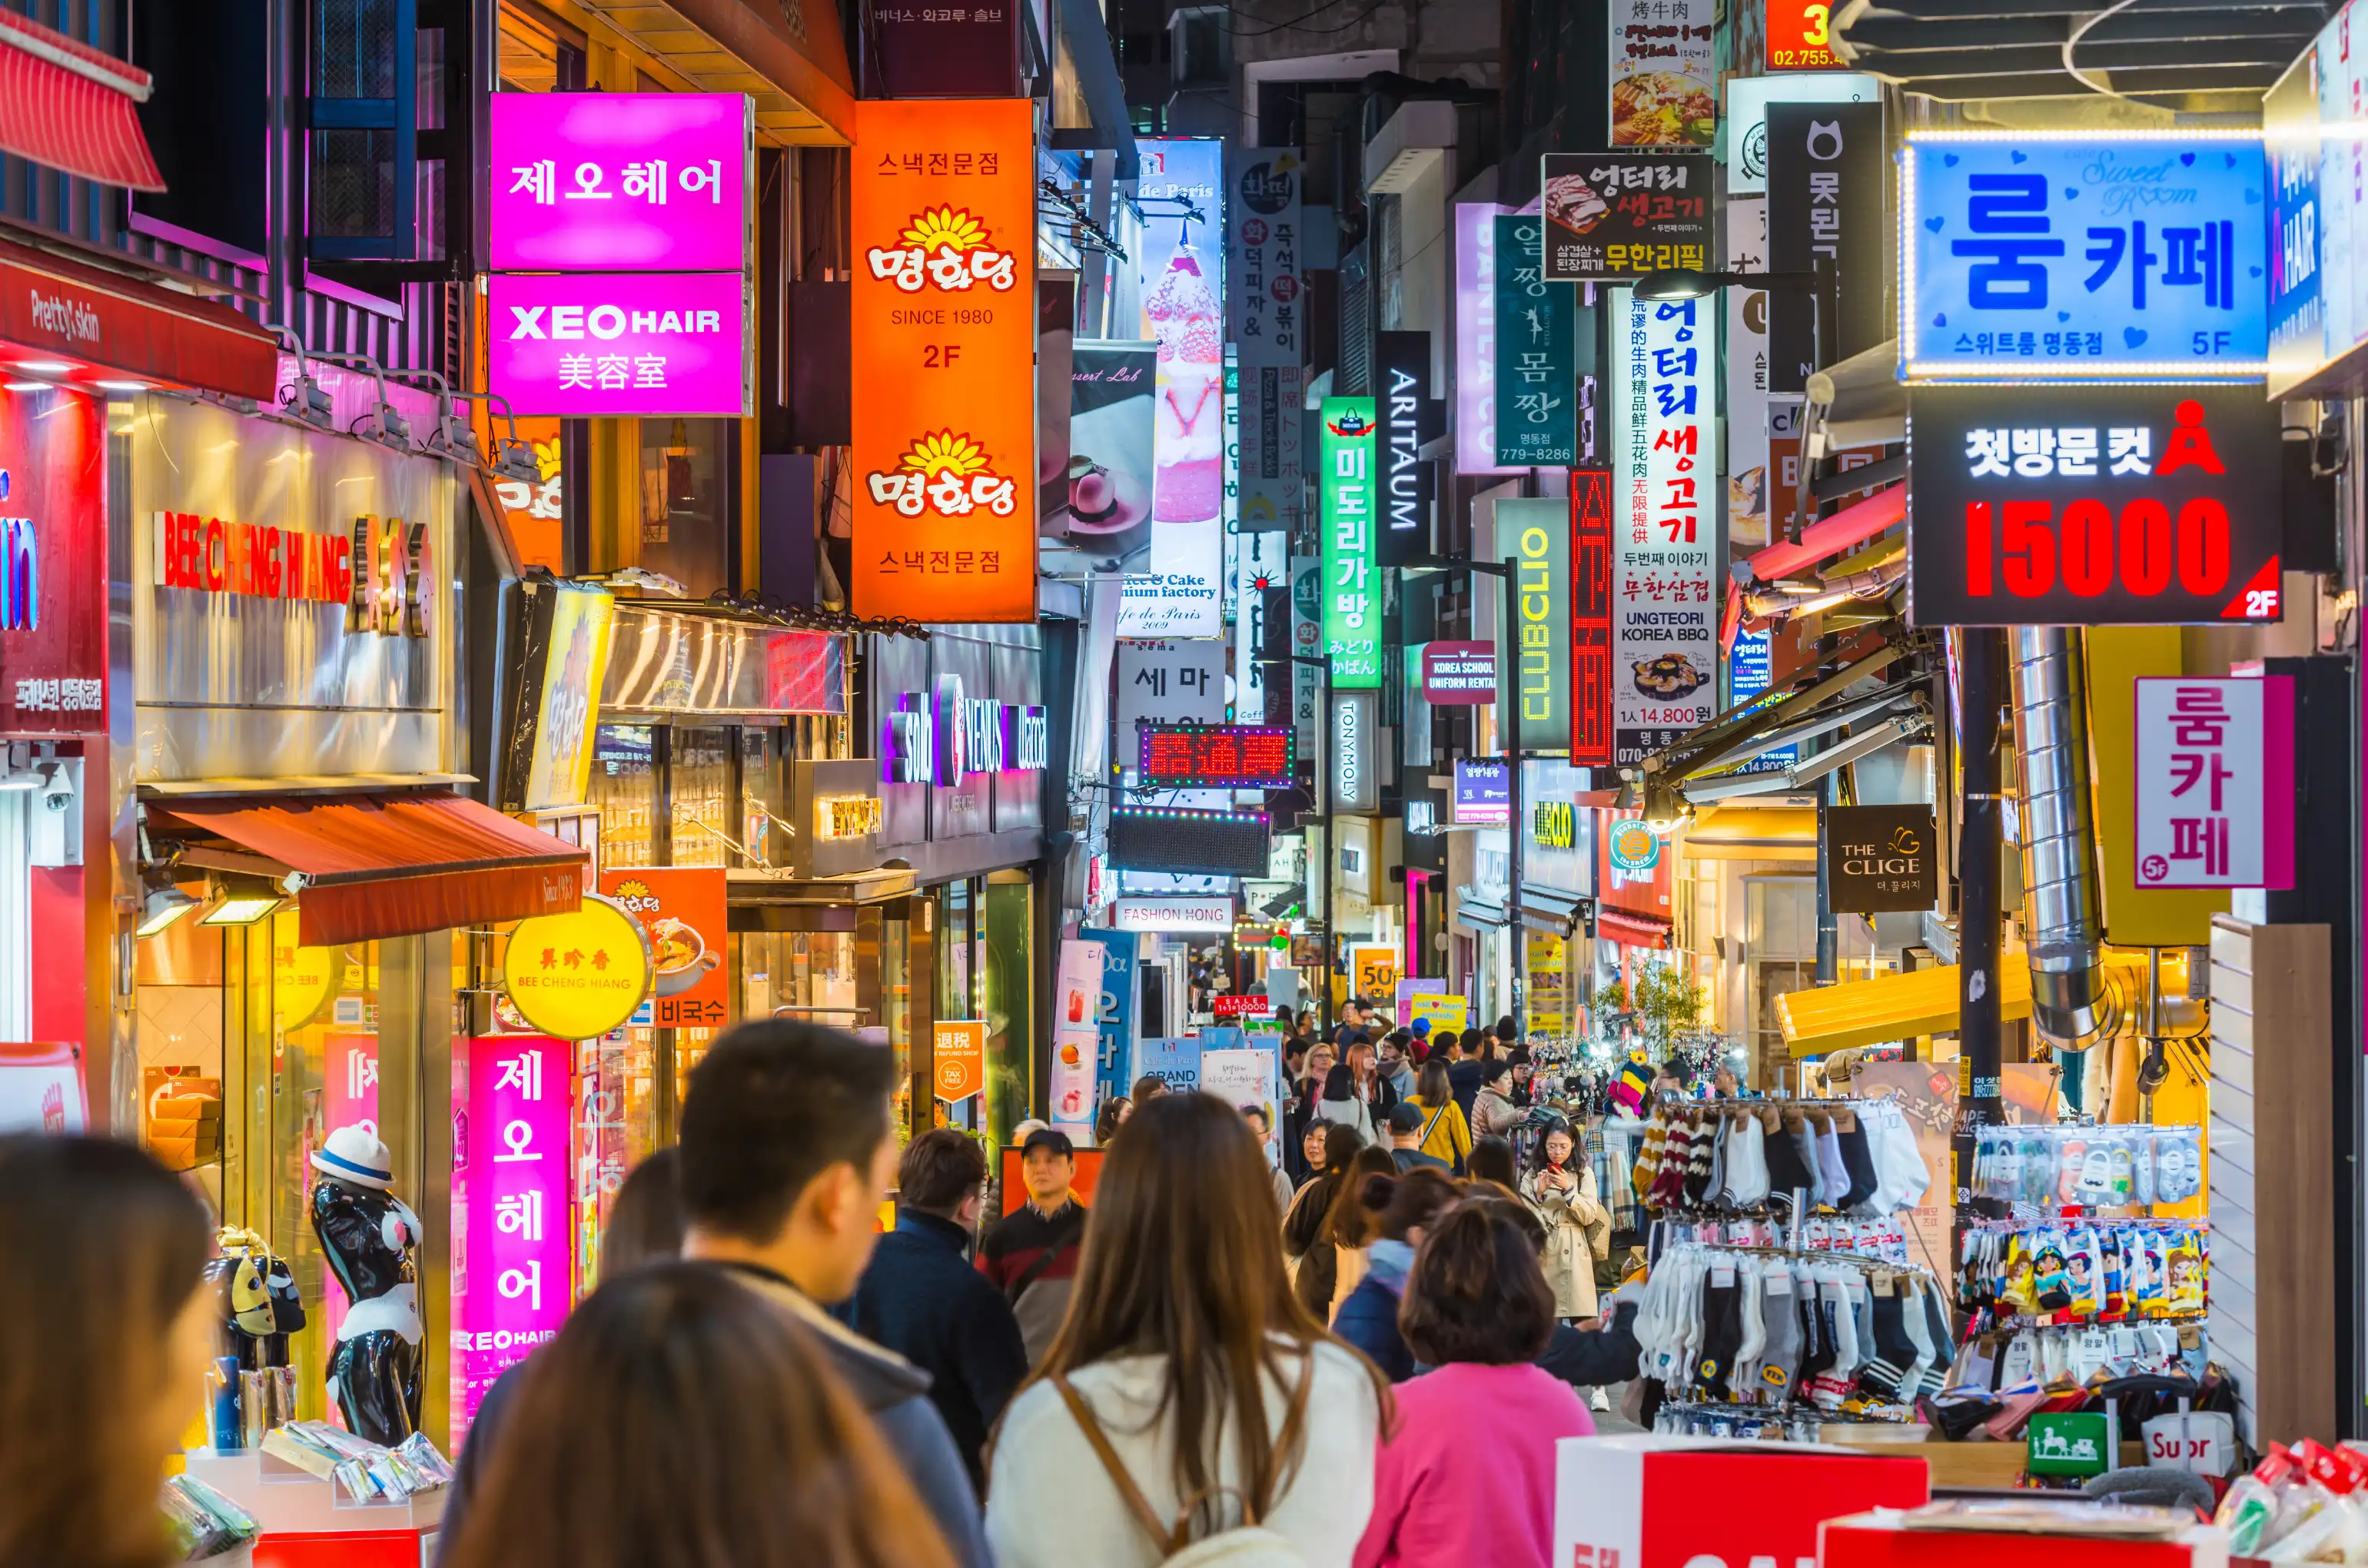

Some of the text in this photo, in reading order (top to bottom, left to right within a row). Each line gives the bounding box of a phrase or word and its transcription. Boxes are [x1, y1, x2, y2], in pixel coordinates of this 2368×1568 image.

[1632, 1, 1689, 19] 烤牛肉
[878, 152, 999, 176] 스낵전문점
[509, 159, 722, 205] 제오헤어
[1138, 183, 1214, 198] de Paris
[1589, 164, 1688, 197] 엉터리
[1617, 194, 1704, 227] 생고기
[867, 246, 1015, 291] 명화당
[1556, 258, 1604, 271] 된장찌개
[1606, 243, 1704, 272] 무한리필
[31, 288, 100, 343] Pretty skin
[892, 309, 994, 325] SINCE 1980
[922, 344, 961, 369] 2F
[1955, 332, 2104, 357] 스위트룸 명동점
[2192, 332, 2232, 357] 5F
[1652, 298, 1699, 418] 엉터리
[559, 352, 669, 391] 美容室
[1106, 367, 1143, 383] Lab
[1390, 367, 1417, 531] ARITAUM
[1519, 434, 1550, 445] 명동점
[1964, 426, 2153, 477] 첫방문 컷
[1501, 448, 1570, 461] 779-8286
[868, 471, 1015, 517] 명화당
[1653, 424, 1699, 544] 생고기
[1336, 447, 1370, 629] 미도리가방
[1965, 497, 2232, 598] 15000
[164, 510, 350, 605] BEE CHENG HIANG
[878, 550, 1001, 574] 스낵전문점
[1623, 552, 1708, 568] 두번째 이야기
[1167, 574, 1205, 586] Cake
[1622, 576, 1710, 603] 무한삼겹
[1161, 586, 1217, 600] factory
[2244, 590, 2278, 617] 2F
[1139, 606, 1156, 620] de
[1161, 606, 1202, 620] Paris
[1626, 612, 1705, 626] UNGTEORI
[1141, 621, 1169, 630] 2009
[1621, 628, 1710, 643] KOREA BBQ
[1330, 639, 1374, 655] みどり
[1332, 659, 1376, 676] かばん
[1433, 661, 1494, 674] KOREA SCHOOL
[1429, 677, 1466, 689] UNIFORM
[965, 697, 1003, 773] VENUS
[1342, 703, 1355, 801] TONYMOLY
[2168, 686, 2233, 876] 룸카페
[1841, 844, 1875, 856] THE
[1843, 858, 1921, 875] CLIGE
[1124, 909, 1181, 922] FASHION
[518, 976, 631, 990] BEE CHENG HIANG
[654, 999, 725, 1023] 비국수
[936, 1031, 971, 1049] 退税
[944, 1070, 961, 1078] TAX
